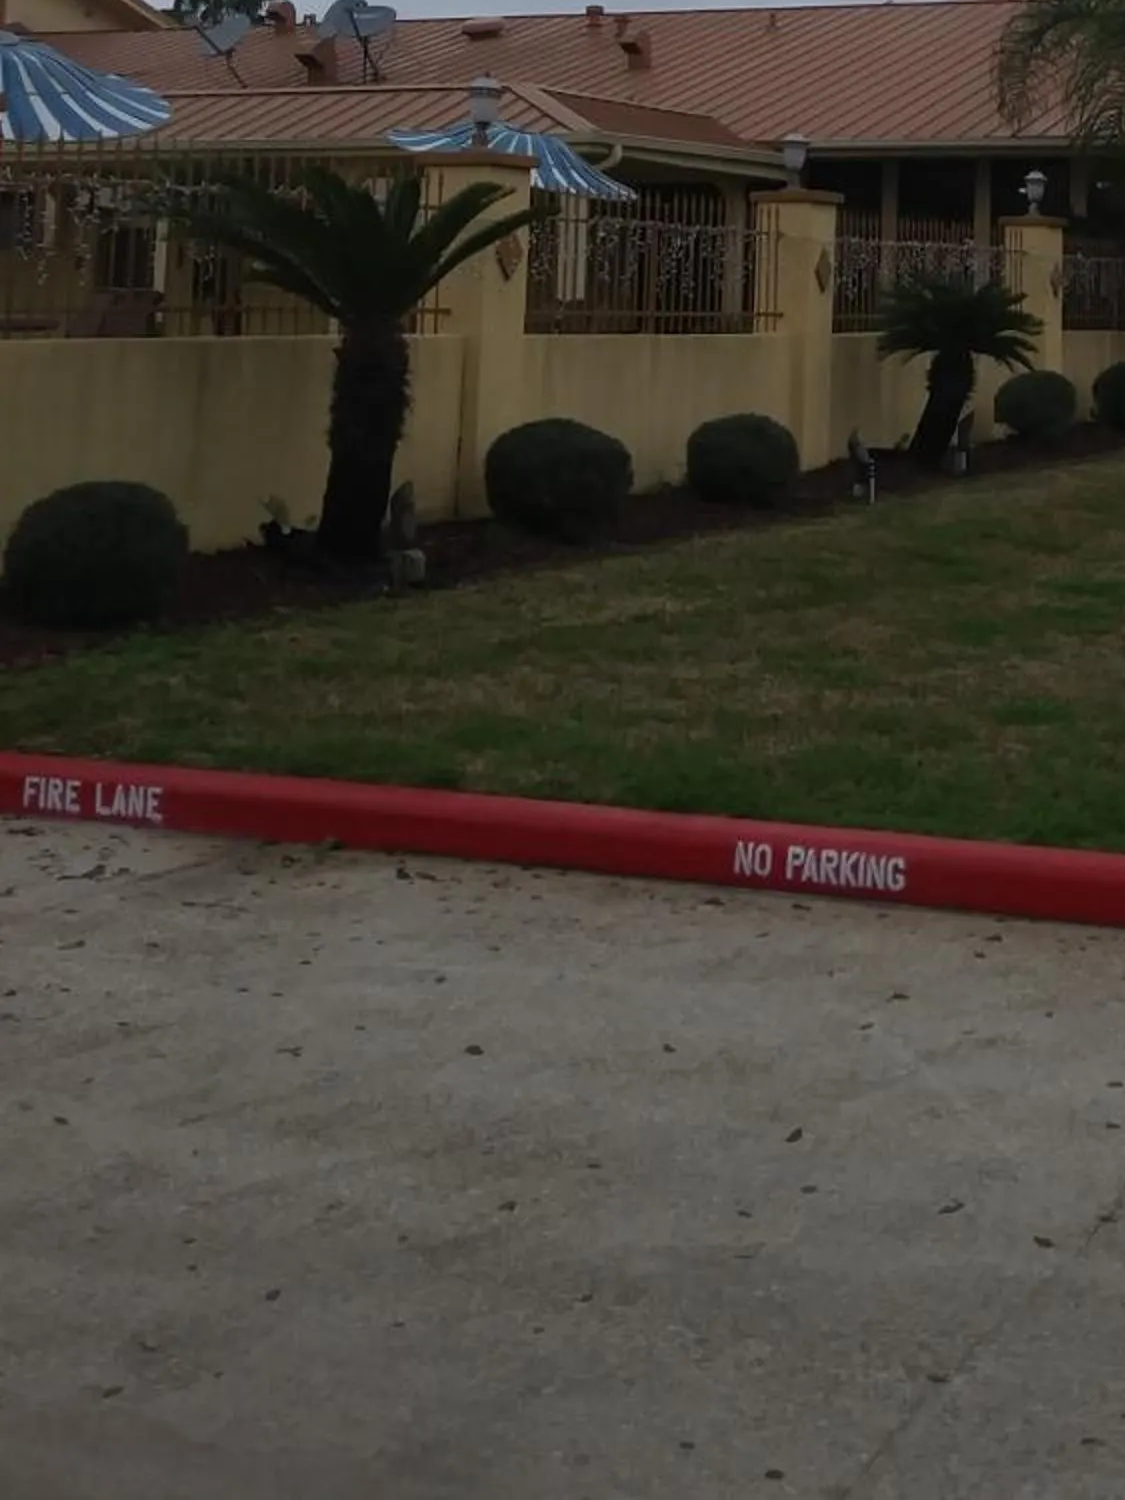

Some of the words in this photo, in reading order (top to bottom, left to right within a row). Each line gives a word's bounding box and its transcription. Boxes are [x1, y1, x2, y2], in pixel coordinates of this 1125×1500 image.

[23, 775, 81, 812] FIRE
[95, 783, 163, 821] LANE
[733, 840, 772, 877] NO
[785, 845, 906, 891] PARKING
